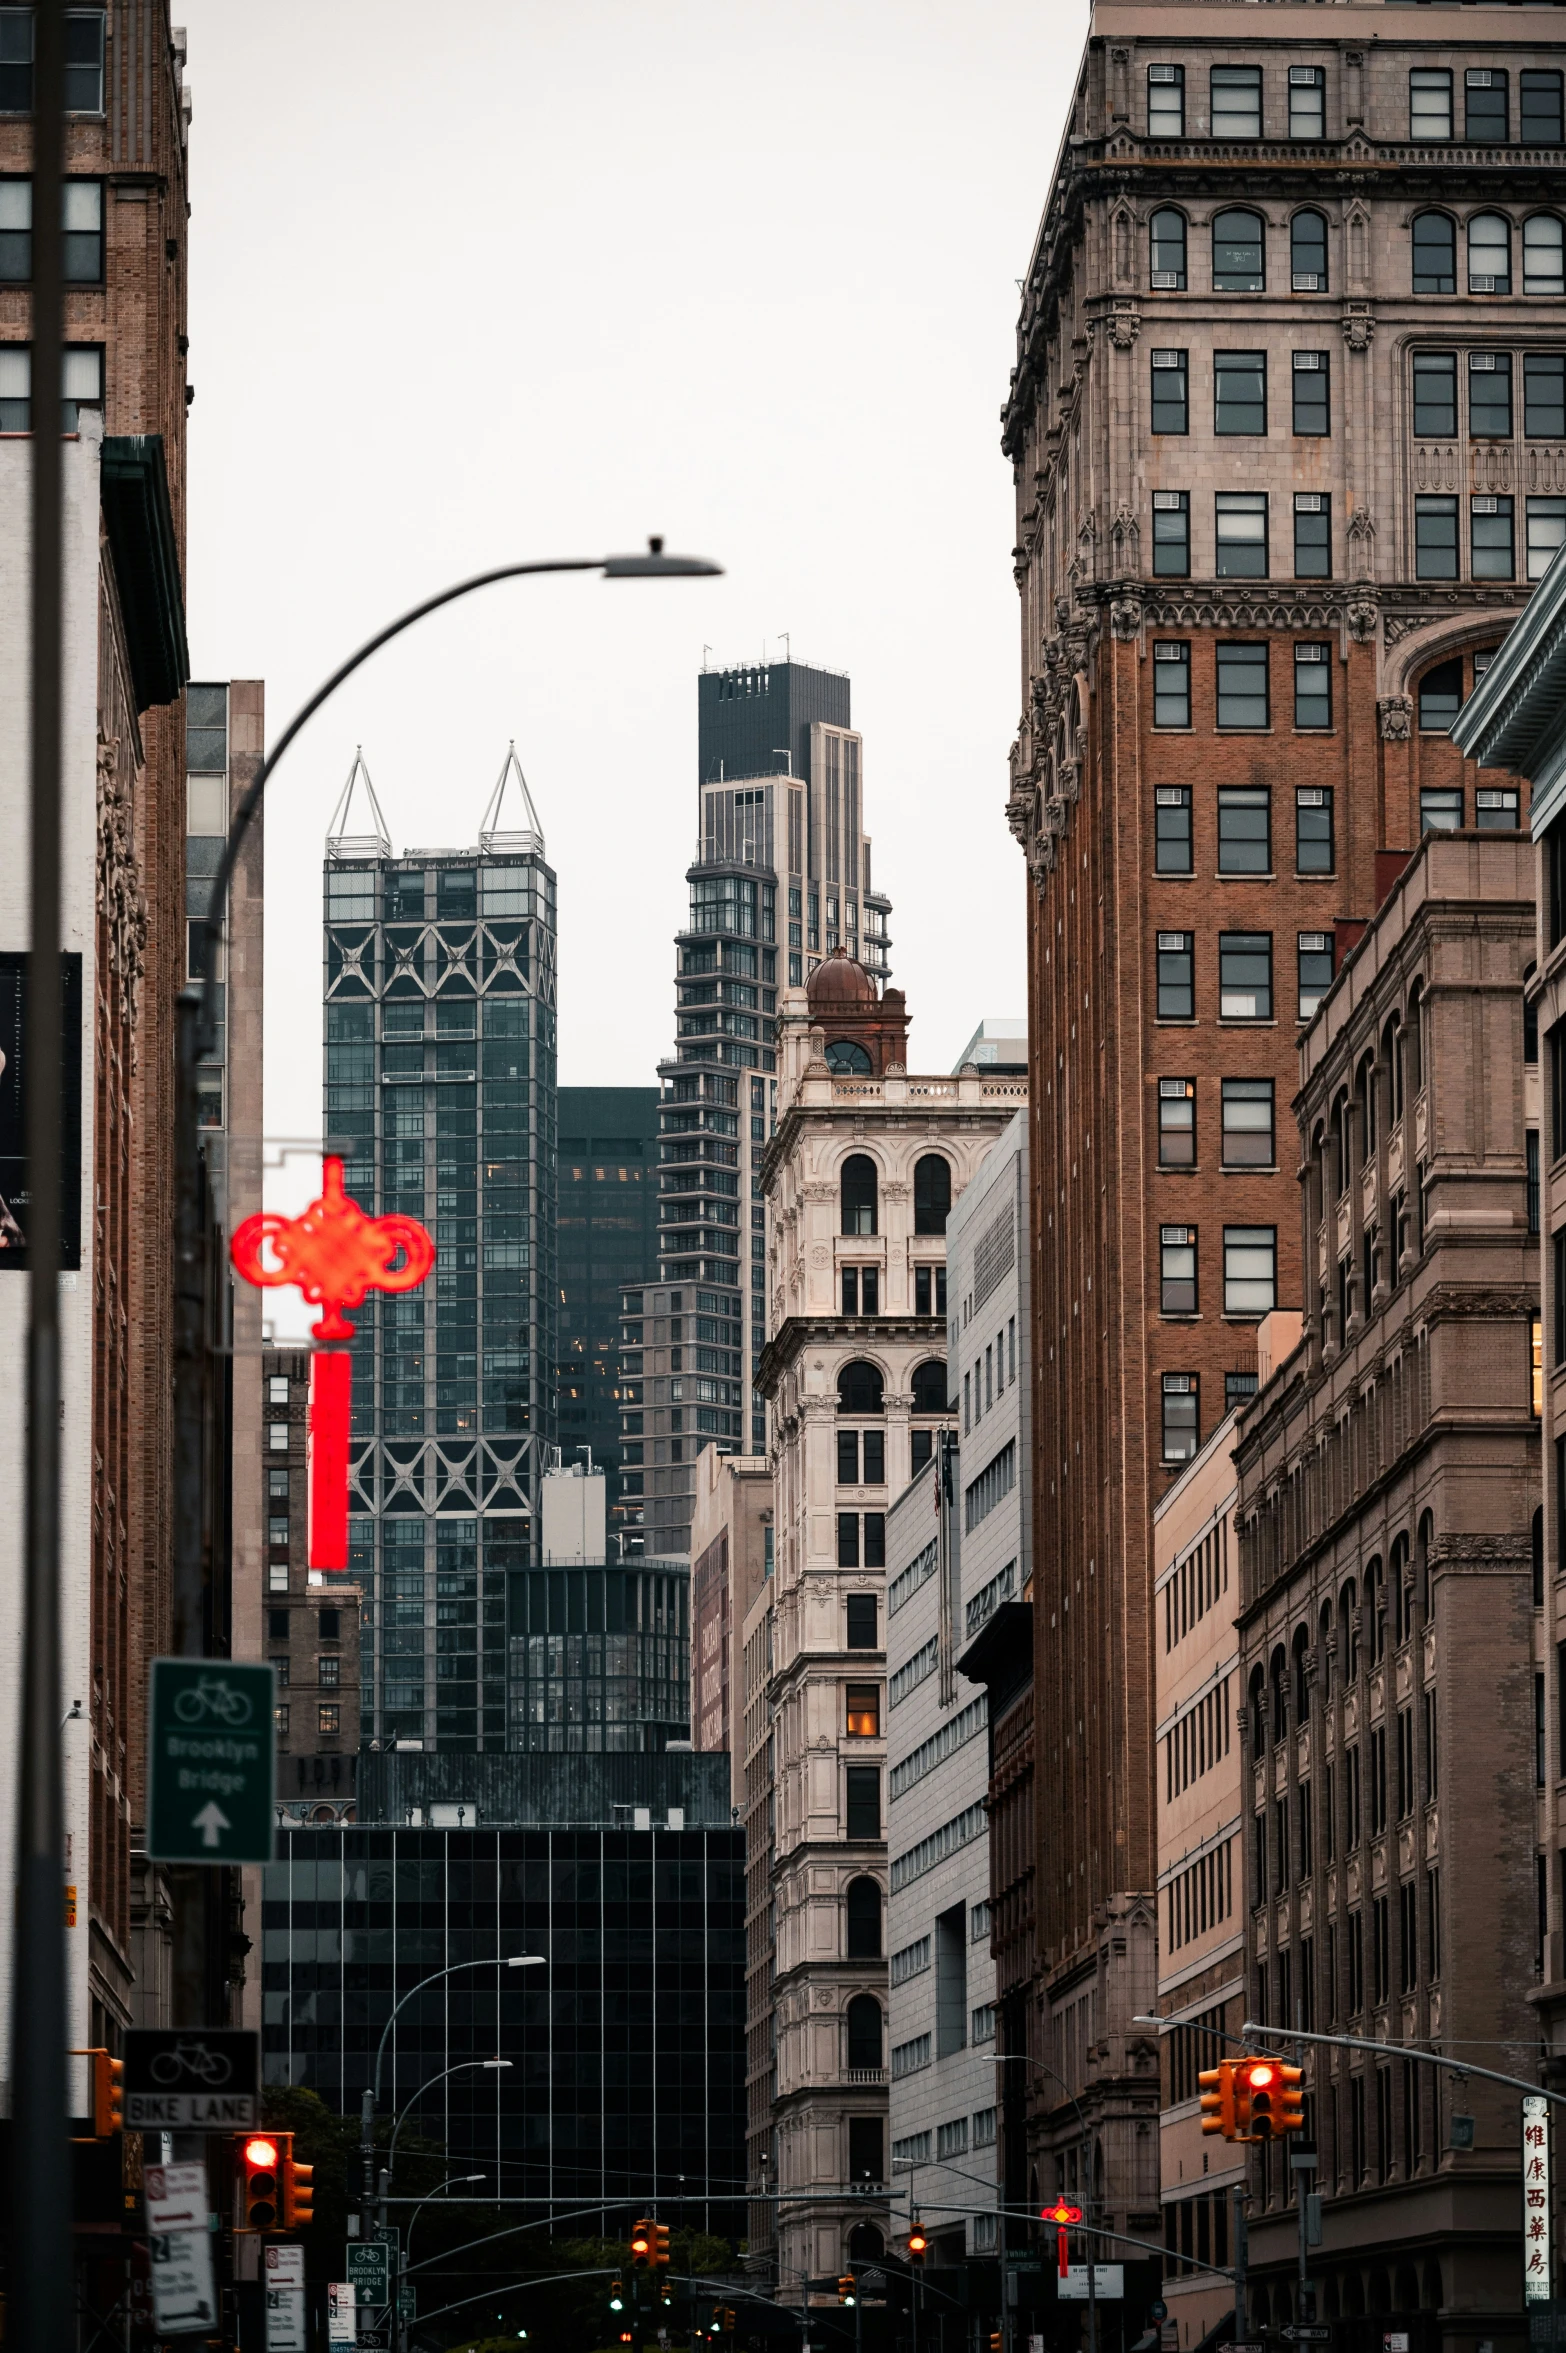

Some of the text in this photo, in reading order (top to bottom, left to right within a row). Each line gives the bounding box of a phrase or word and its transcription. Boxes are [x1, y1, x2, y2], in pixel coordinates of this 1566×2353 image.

[20, 1190, 34, 1198] STA
[166, 1736, 260, 1765] Brooklyn
[177, 1767, 247, 1797] Bridge
[130, 2097, 250, 2121] BIKE LANE
[1525, 2124, 1547, 2275] 維康西藥房
[1009, 2249, 1028, 2258] White
[349, 2266, 386, 2276] BROOKLYN
[353, 2277, 382, 2286] BRIDGE
[1286, 2329, 1327, 2337] ONE WAY
[1222, 2345, 1261, 2353] ONE WAY
